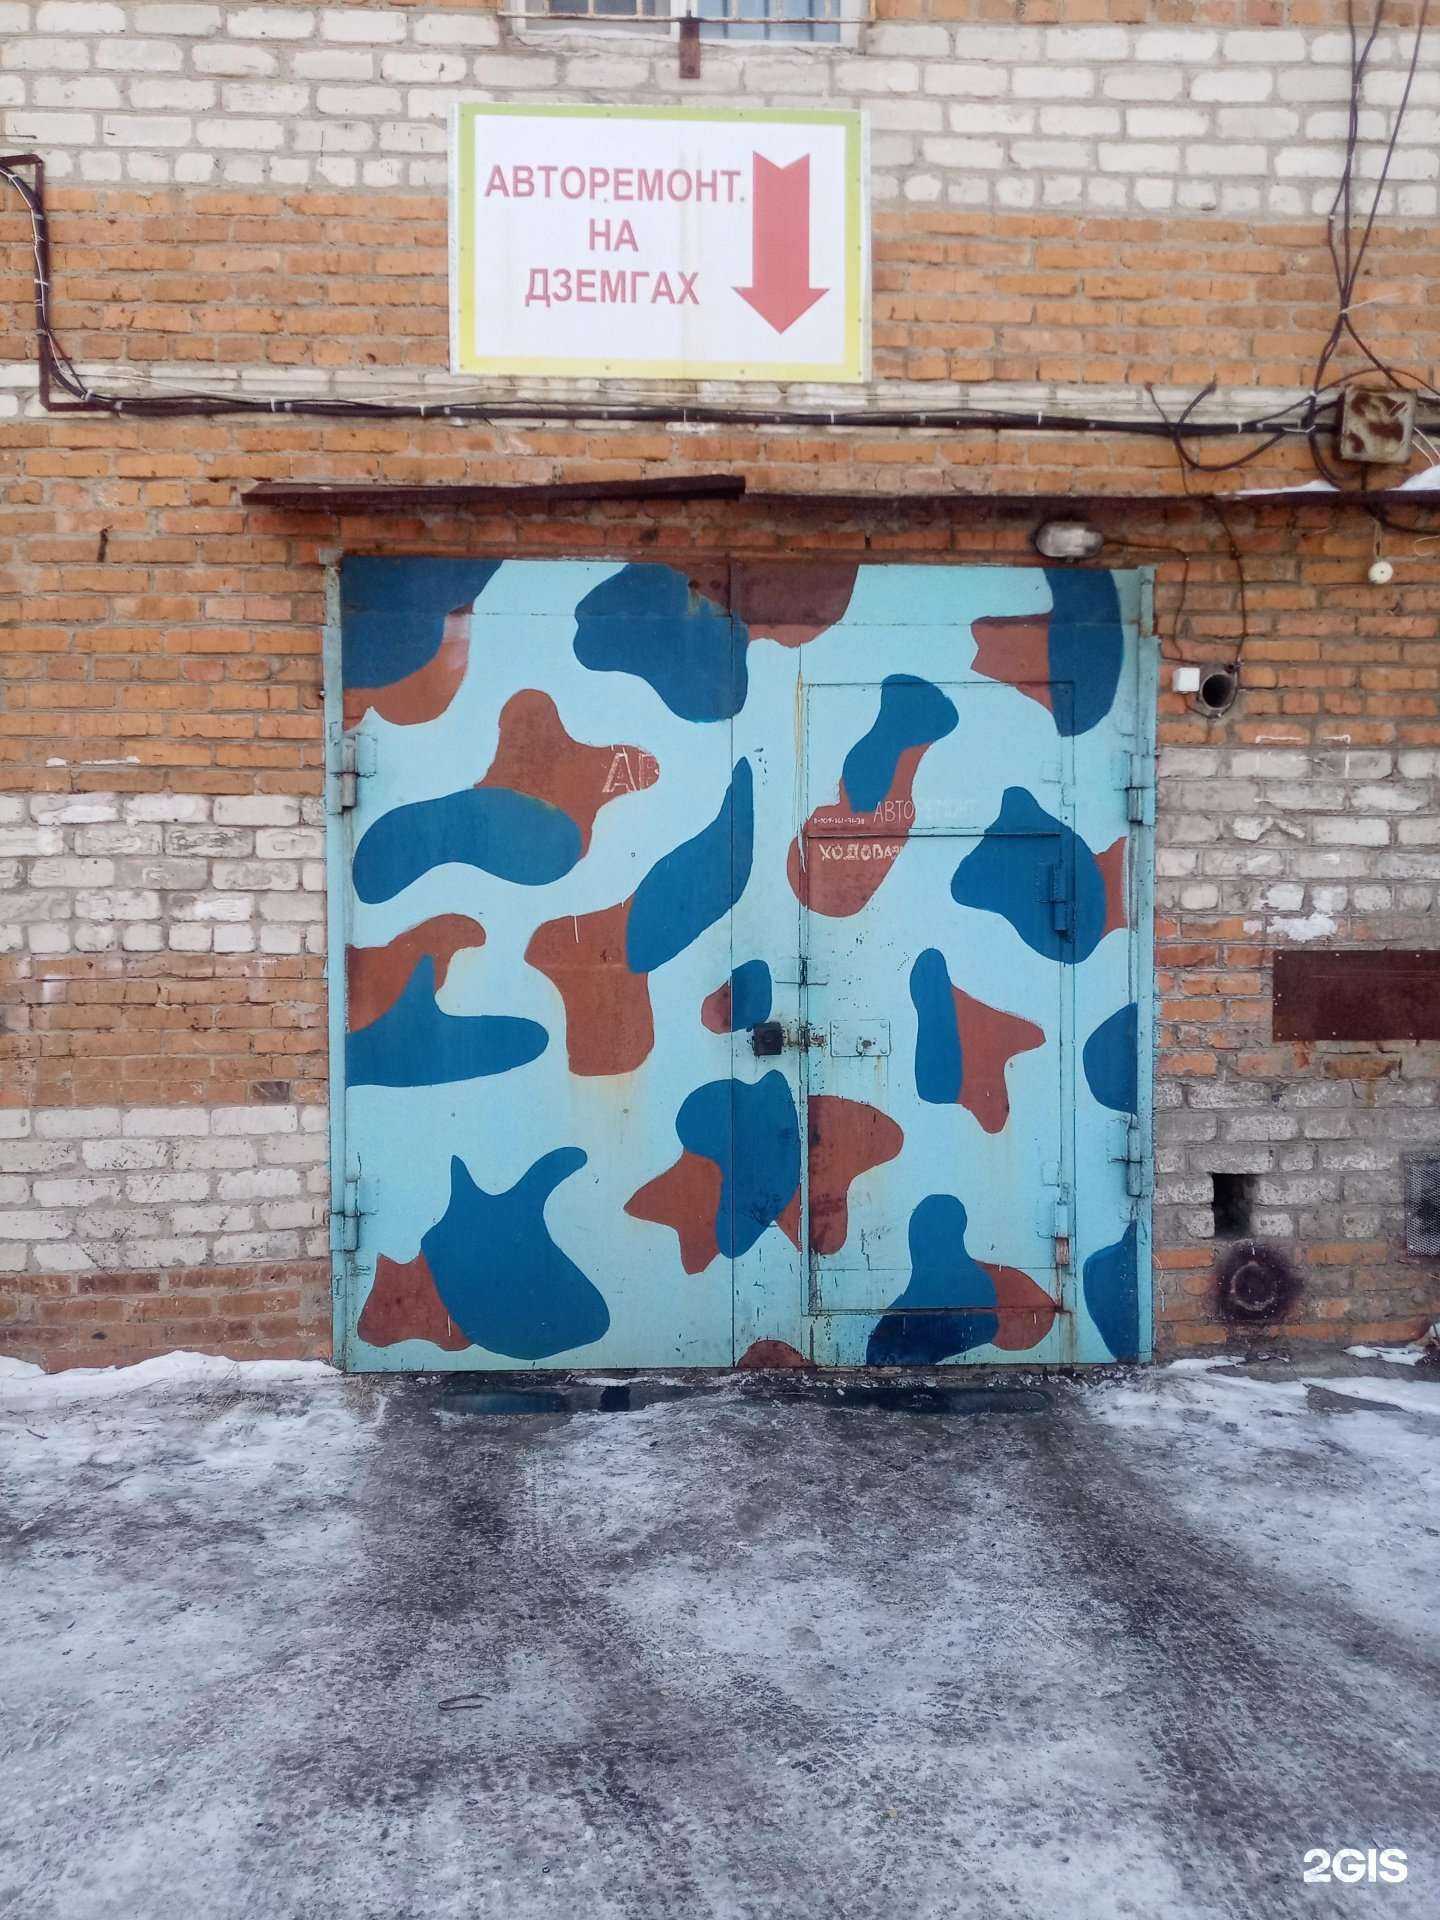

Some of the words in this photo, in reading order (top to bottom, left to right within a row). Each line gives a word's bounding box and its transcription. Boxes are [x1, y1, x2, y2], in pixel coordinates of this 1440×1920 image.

[484, 164, 742, 202] АВТОРЕМОНТ
[588, 218, 639, 252] НА
[524, 268, 700, 308] ДЗЕМГАХ
